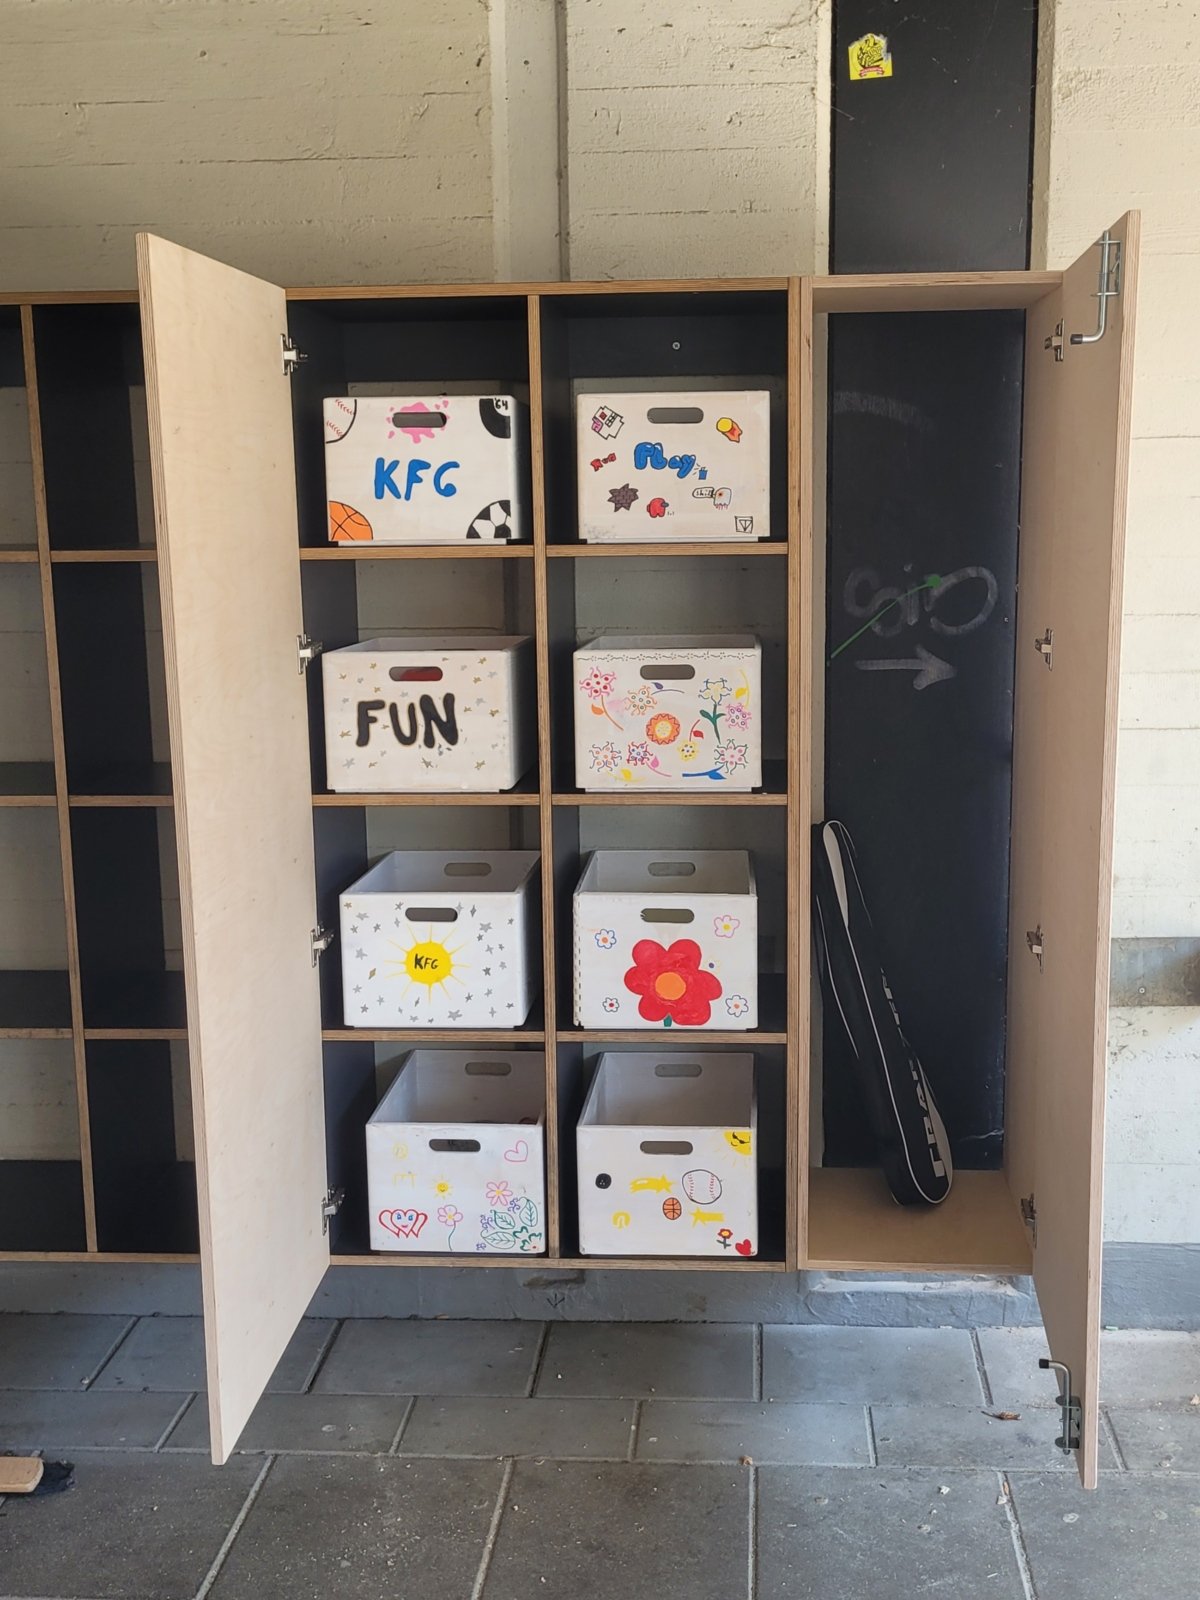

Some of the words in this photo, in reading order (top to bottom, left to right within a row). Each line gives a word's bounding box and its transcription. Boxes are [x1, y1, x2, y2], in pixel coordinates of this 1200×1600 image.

[374, 457, 460, 501] KFG
[356, 692, 459, 749] FUN
[414, 953, 439, 970] KFG
